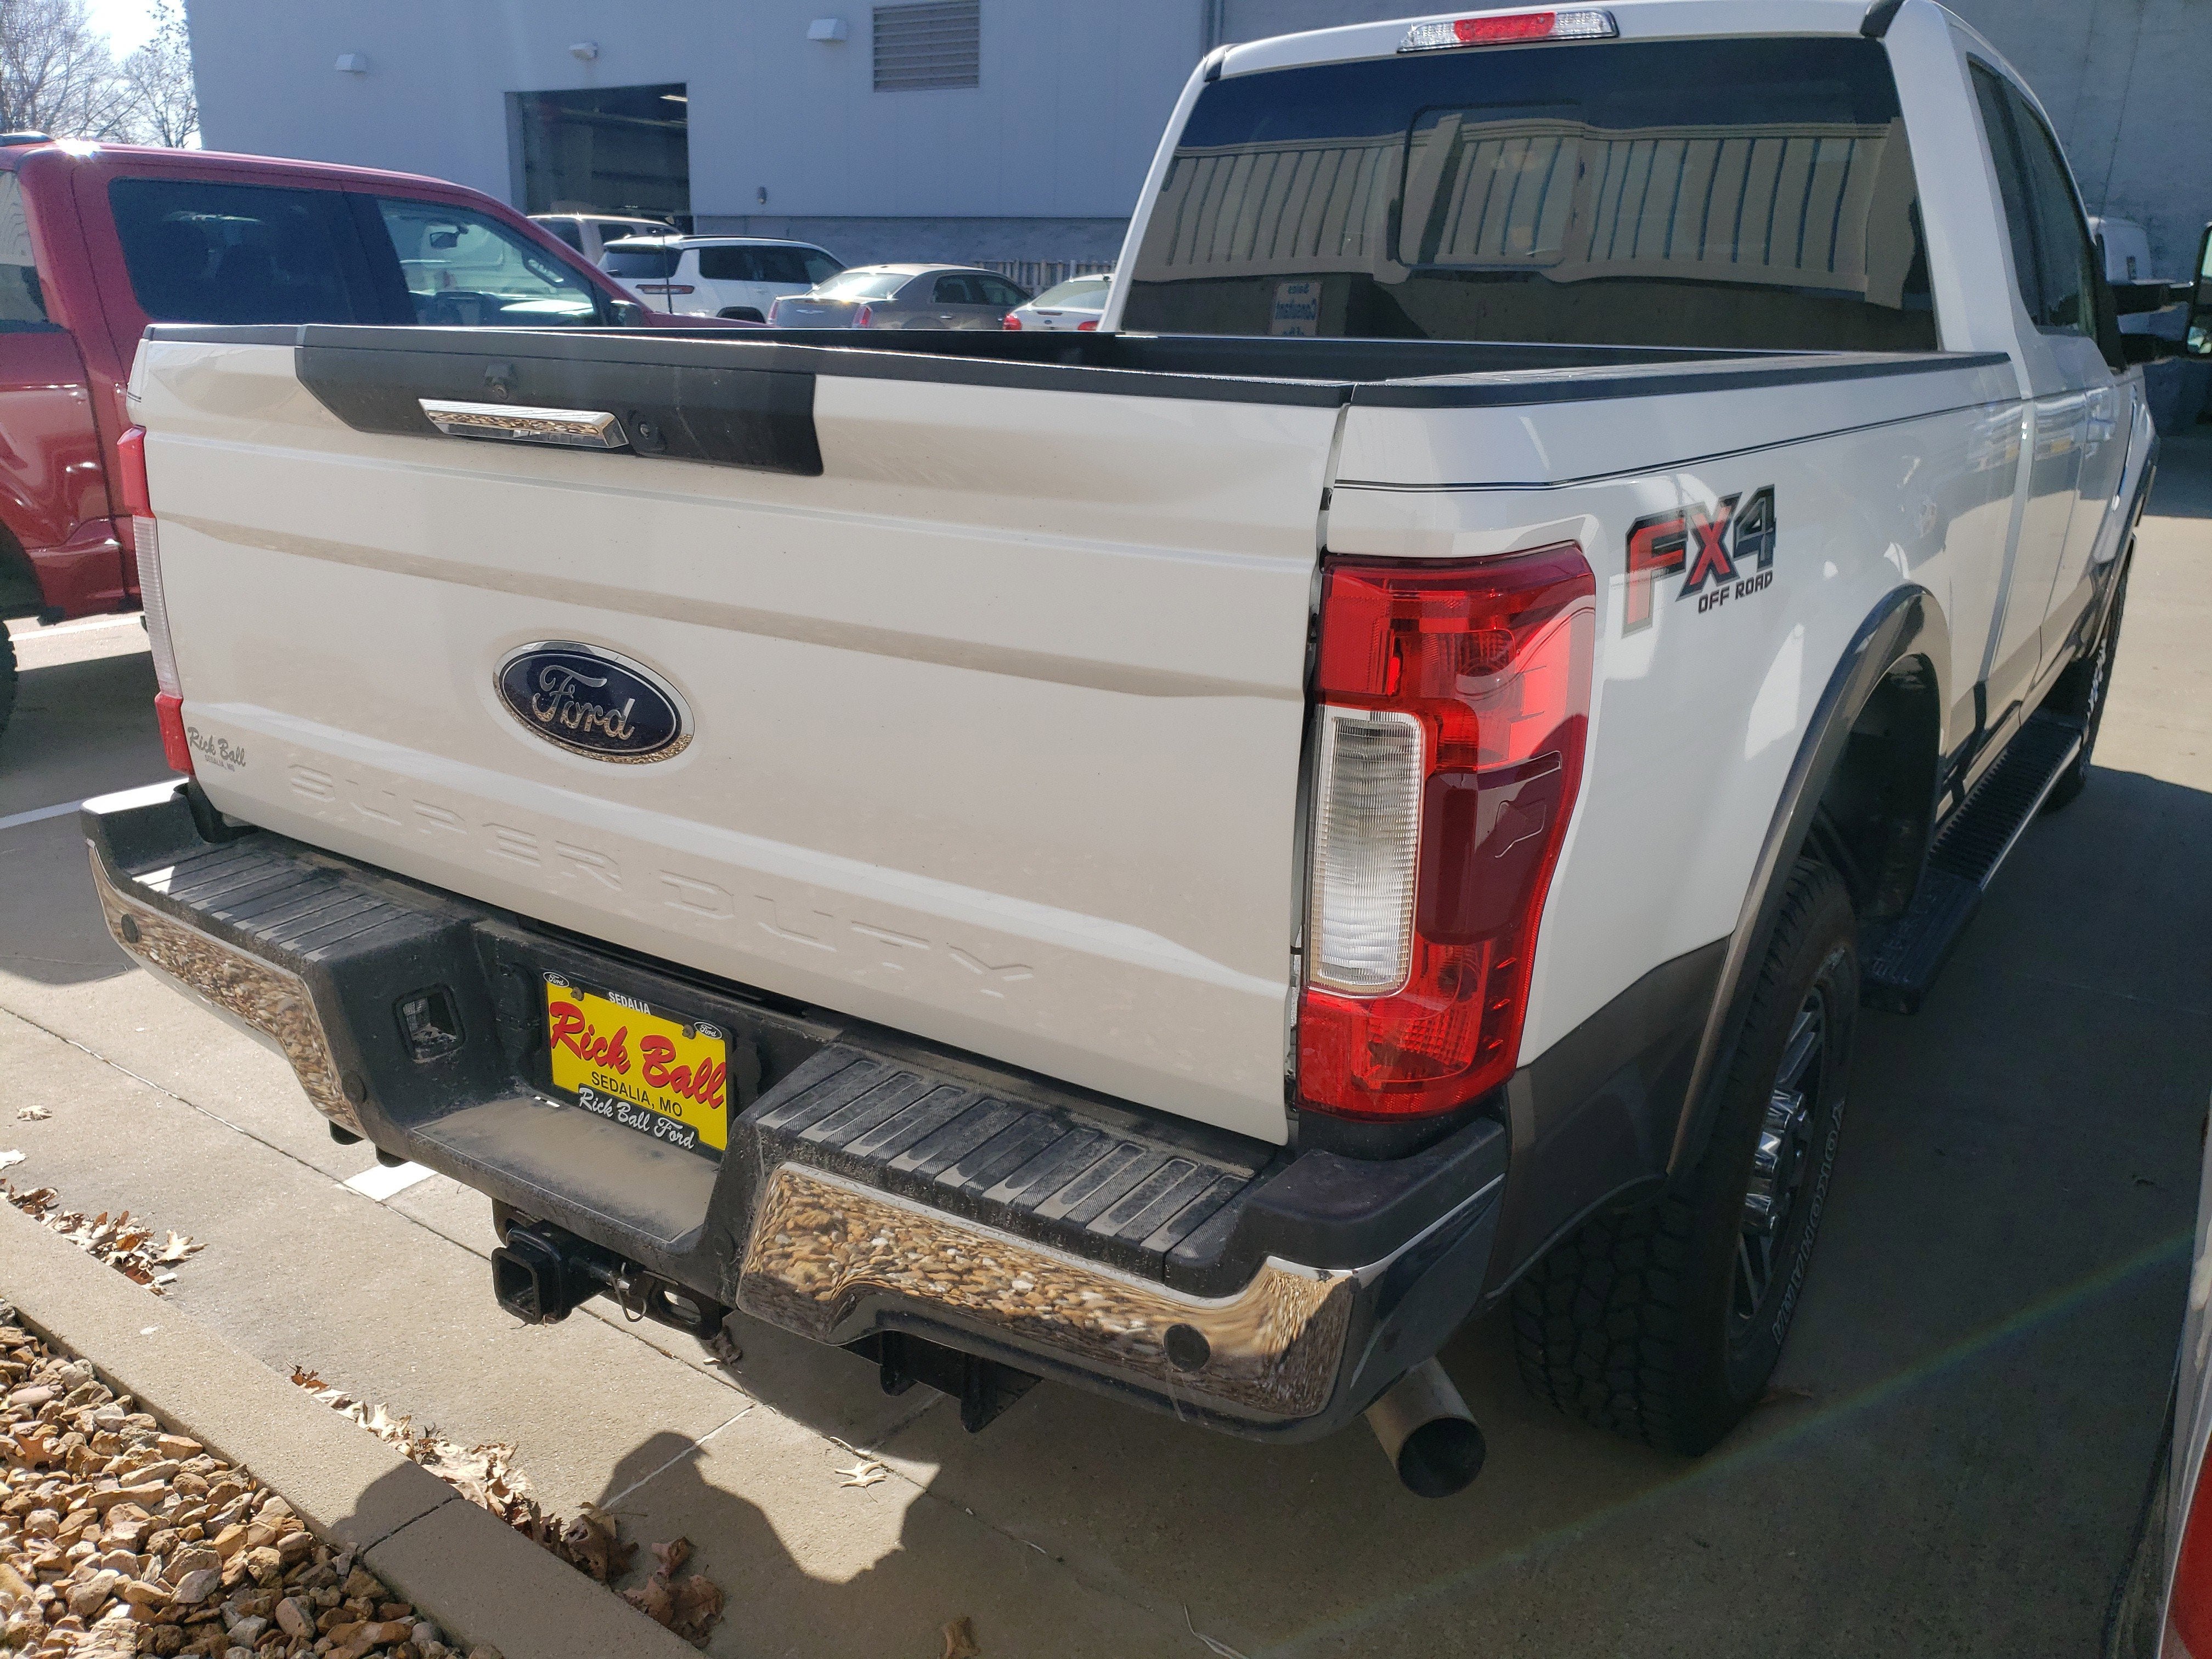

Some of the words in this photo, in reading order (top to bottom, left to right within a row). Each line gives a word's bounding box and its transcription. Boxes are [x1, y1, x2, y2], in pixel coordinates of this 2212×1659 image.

[1622, 484, 1776, 639] FX4
[1698, 586, 1730, 614] OFF
[1735, 571, 1773, 600] ROAD
[532, 665, 636, 740] Ford
[187, 726, 216, 755] Rick
[218, 738, 246, 767] Ball
[289, 764, 623, 893] SUPER
[659, 869, 1032, 998] DUTY
[548, 974, 565, 986] Ford
[608, 991, 651, 1015] SEDALIA
[699, 1024, 718, 1037] Ford
[550, 1001, 631, 1075] Rick
[640, 1034, 726, 1109] Ball
[591, 1071, 655, 1109] SEDALIA,
[659, 1099, 682, 1117] MO
[578, 1087, 614, 1118] Rick
[617, 1102, 650, 1131] Ball
[654, 1117, 695, 1149] Ford
